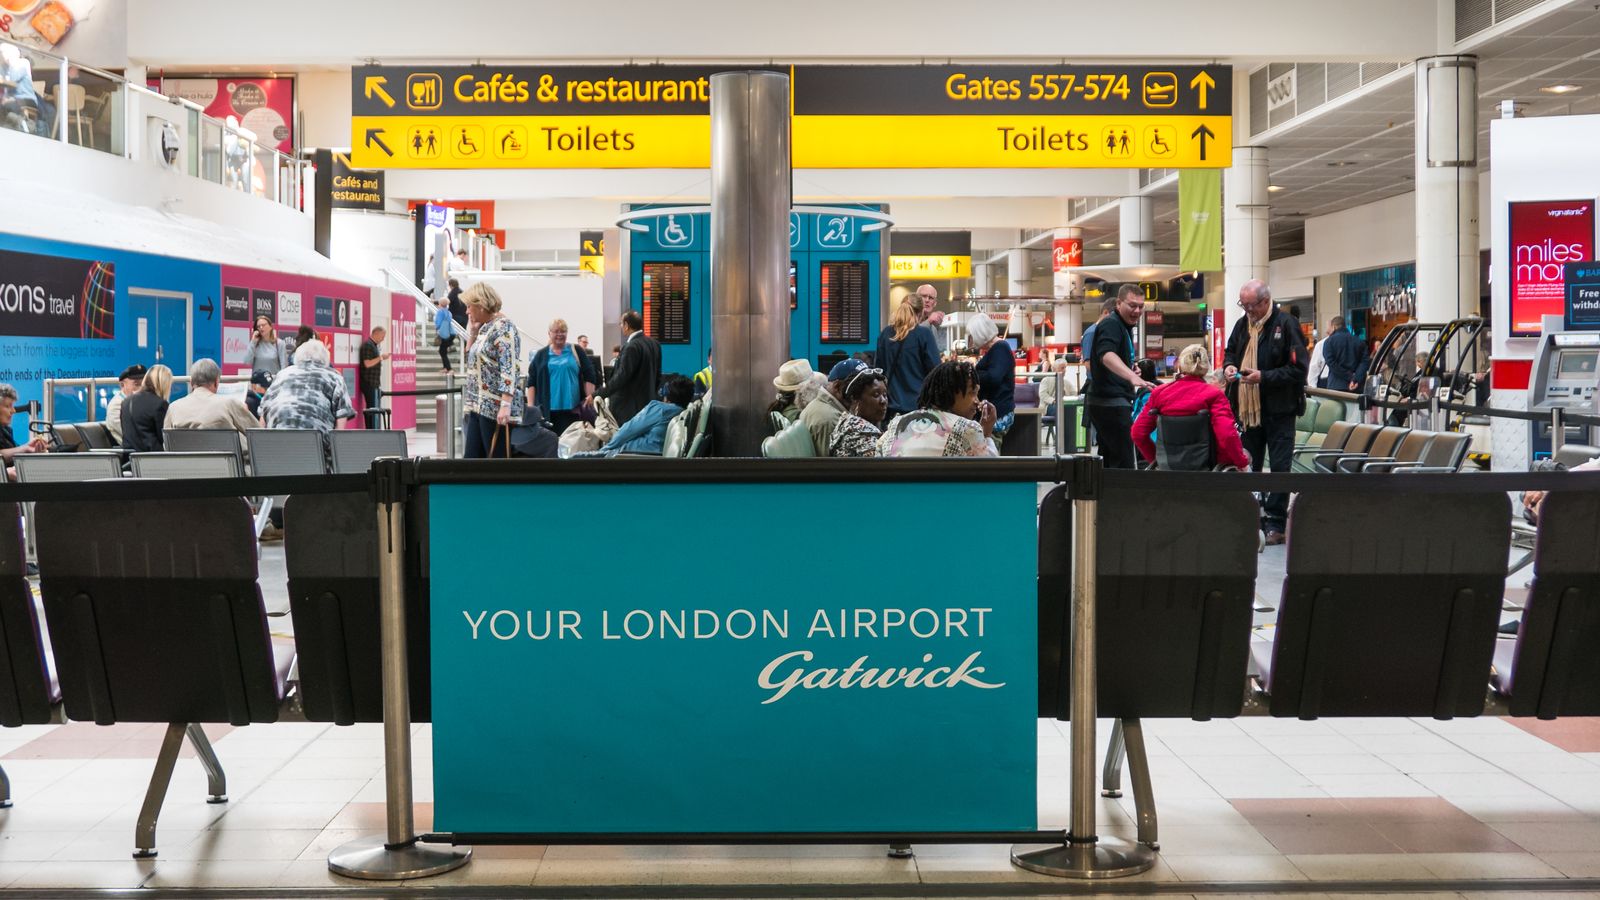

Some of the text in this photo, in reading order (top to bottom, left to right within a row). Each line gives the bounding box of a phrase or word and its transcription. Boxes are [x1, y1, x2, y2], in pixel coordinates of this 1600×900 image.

[453, 73, 711, 103] Cafés & restaurant
[945, 73, 1131, 101] Gates 557-574
[541, 126, 635, 151] Toilets
[997, 126, 1089, 151] Toilets
[333, 175, 378, 190] Cafés and
[1516, 239, 1584, 263] miles
[256, 298, 272, 311] BOSS
[279, 294, 301, 314] Case
[1579, 289, 1600, 298] Free
[49, 294, 75, 316] travel
[1573, 300, 1600, 310] withd
[3, 344, 21, 357] tech
[23, 343, 43, 358] from
[15, 369, 33, 380] ends
[34, 368, 42, 380] of
[44, 368, 55, 379] the
[462, 607, 993, 641] YOUR LONDON AIRPORT
[757, 650, 1006, 705] Gatwick
